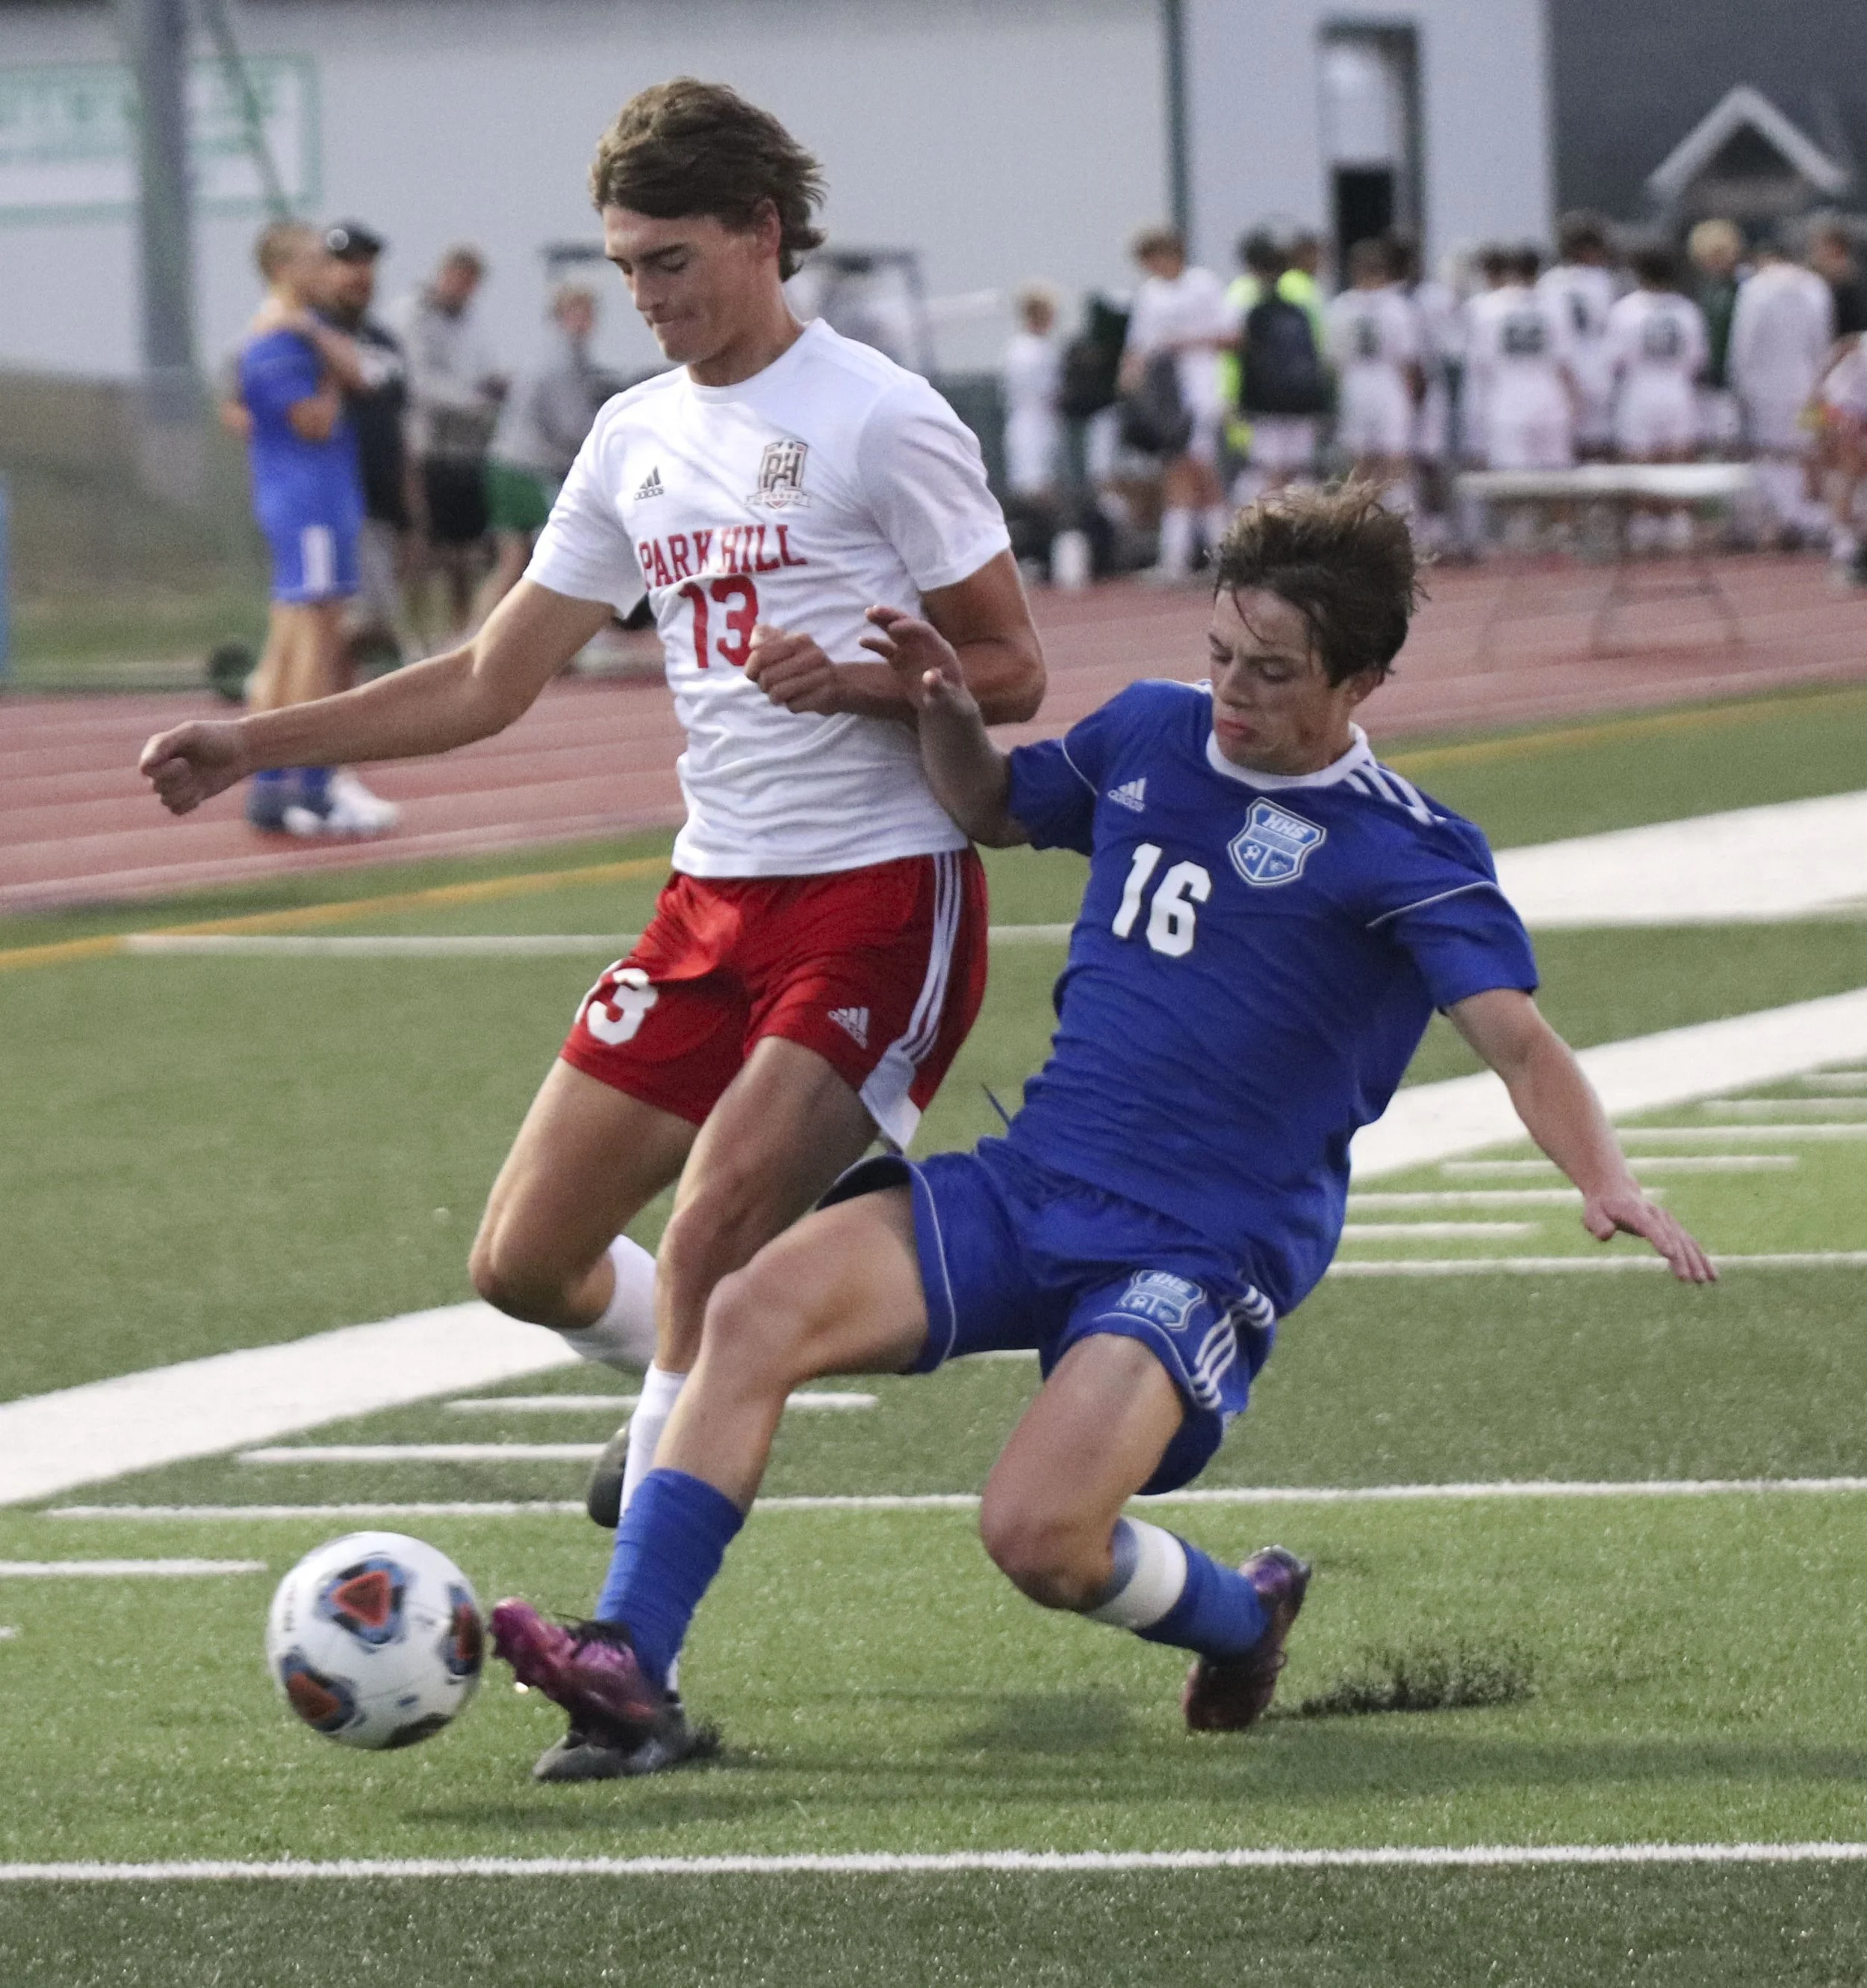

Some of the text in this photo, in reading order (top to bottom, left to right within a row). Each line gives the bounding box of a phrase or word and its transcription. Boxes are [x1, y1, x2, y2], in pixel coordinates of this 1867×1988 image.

[639, 524, 807, 591] PARK HILL
[677, 575, 759, 668] 13
[1112, 842, 1211, 957] 16
